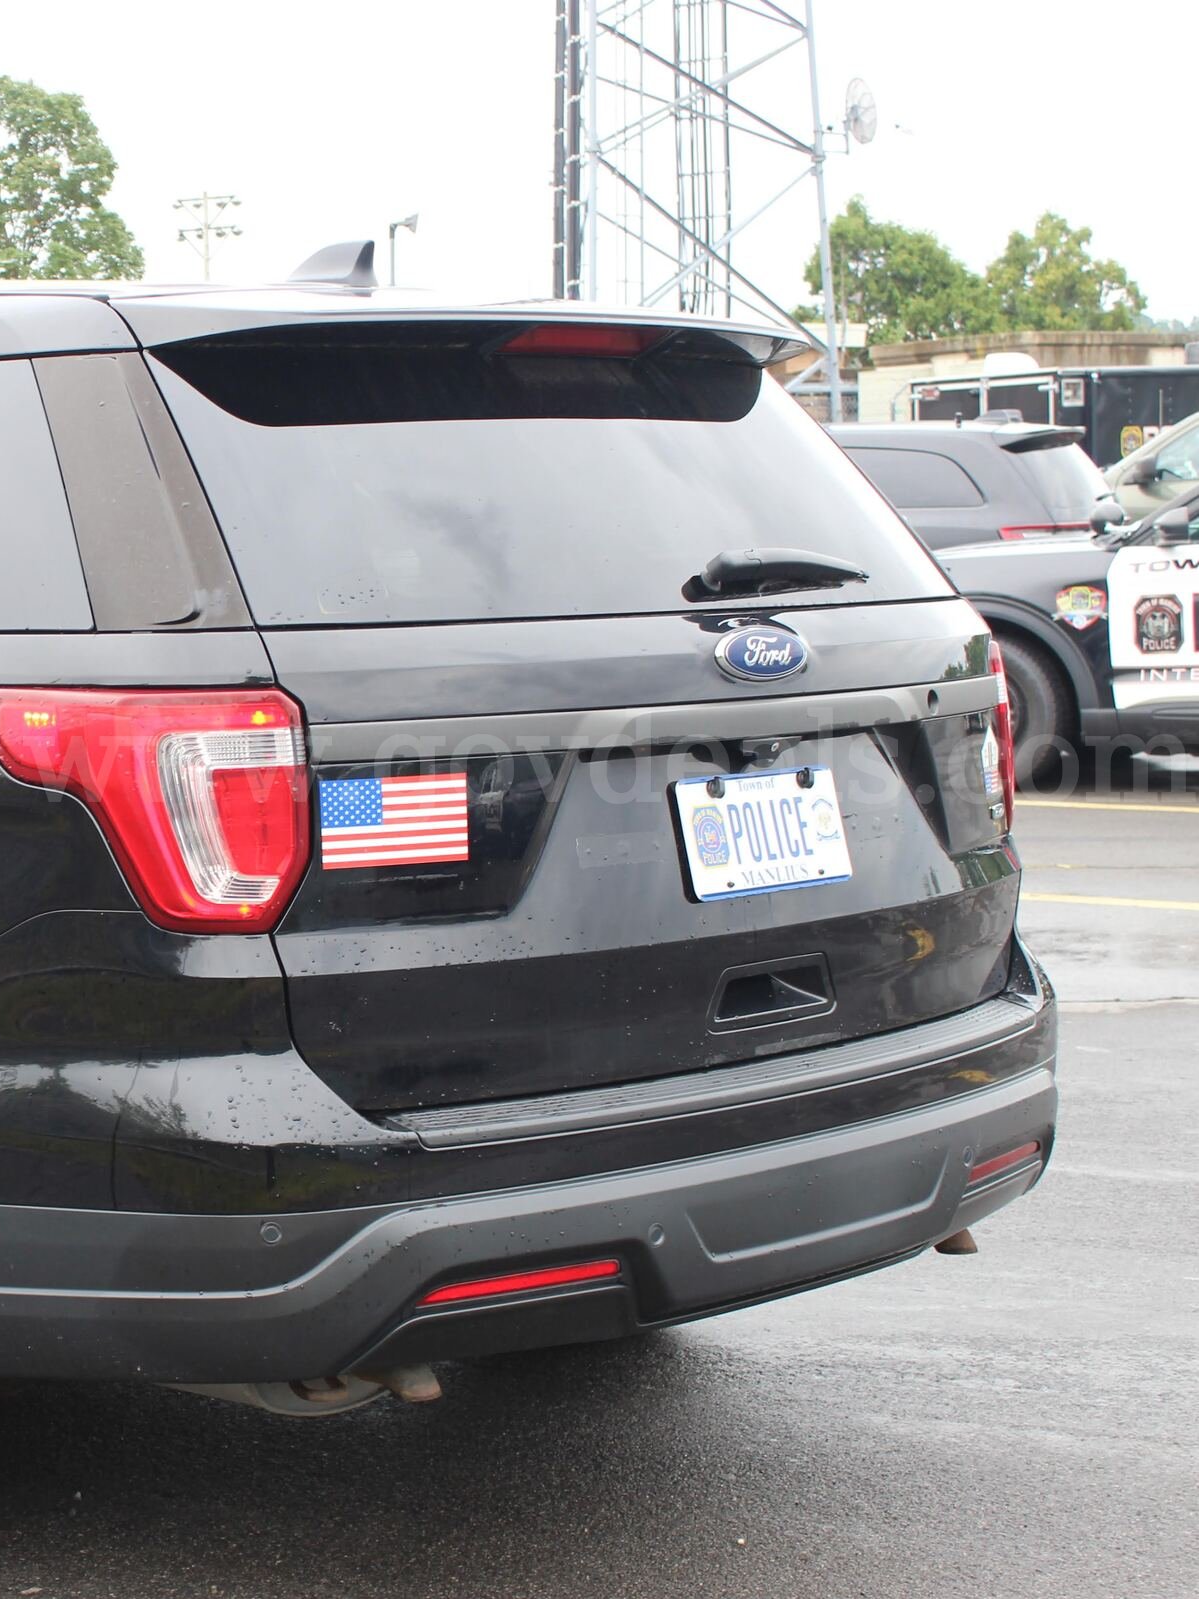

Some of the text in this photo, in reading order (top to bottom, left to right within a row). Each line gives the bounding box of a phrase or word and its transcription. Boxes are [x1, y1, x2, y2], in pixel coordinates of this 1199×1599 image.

[744, 635, 792, 667] Ford
[1142, 636, 1176, 651] POLICE
[736, 777, 776, 792] Town of
[726, 796, 814, 865] POLICE
[741, 864, 809, 887] MANLIUS
